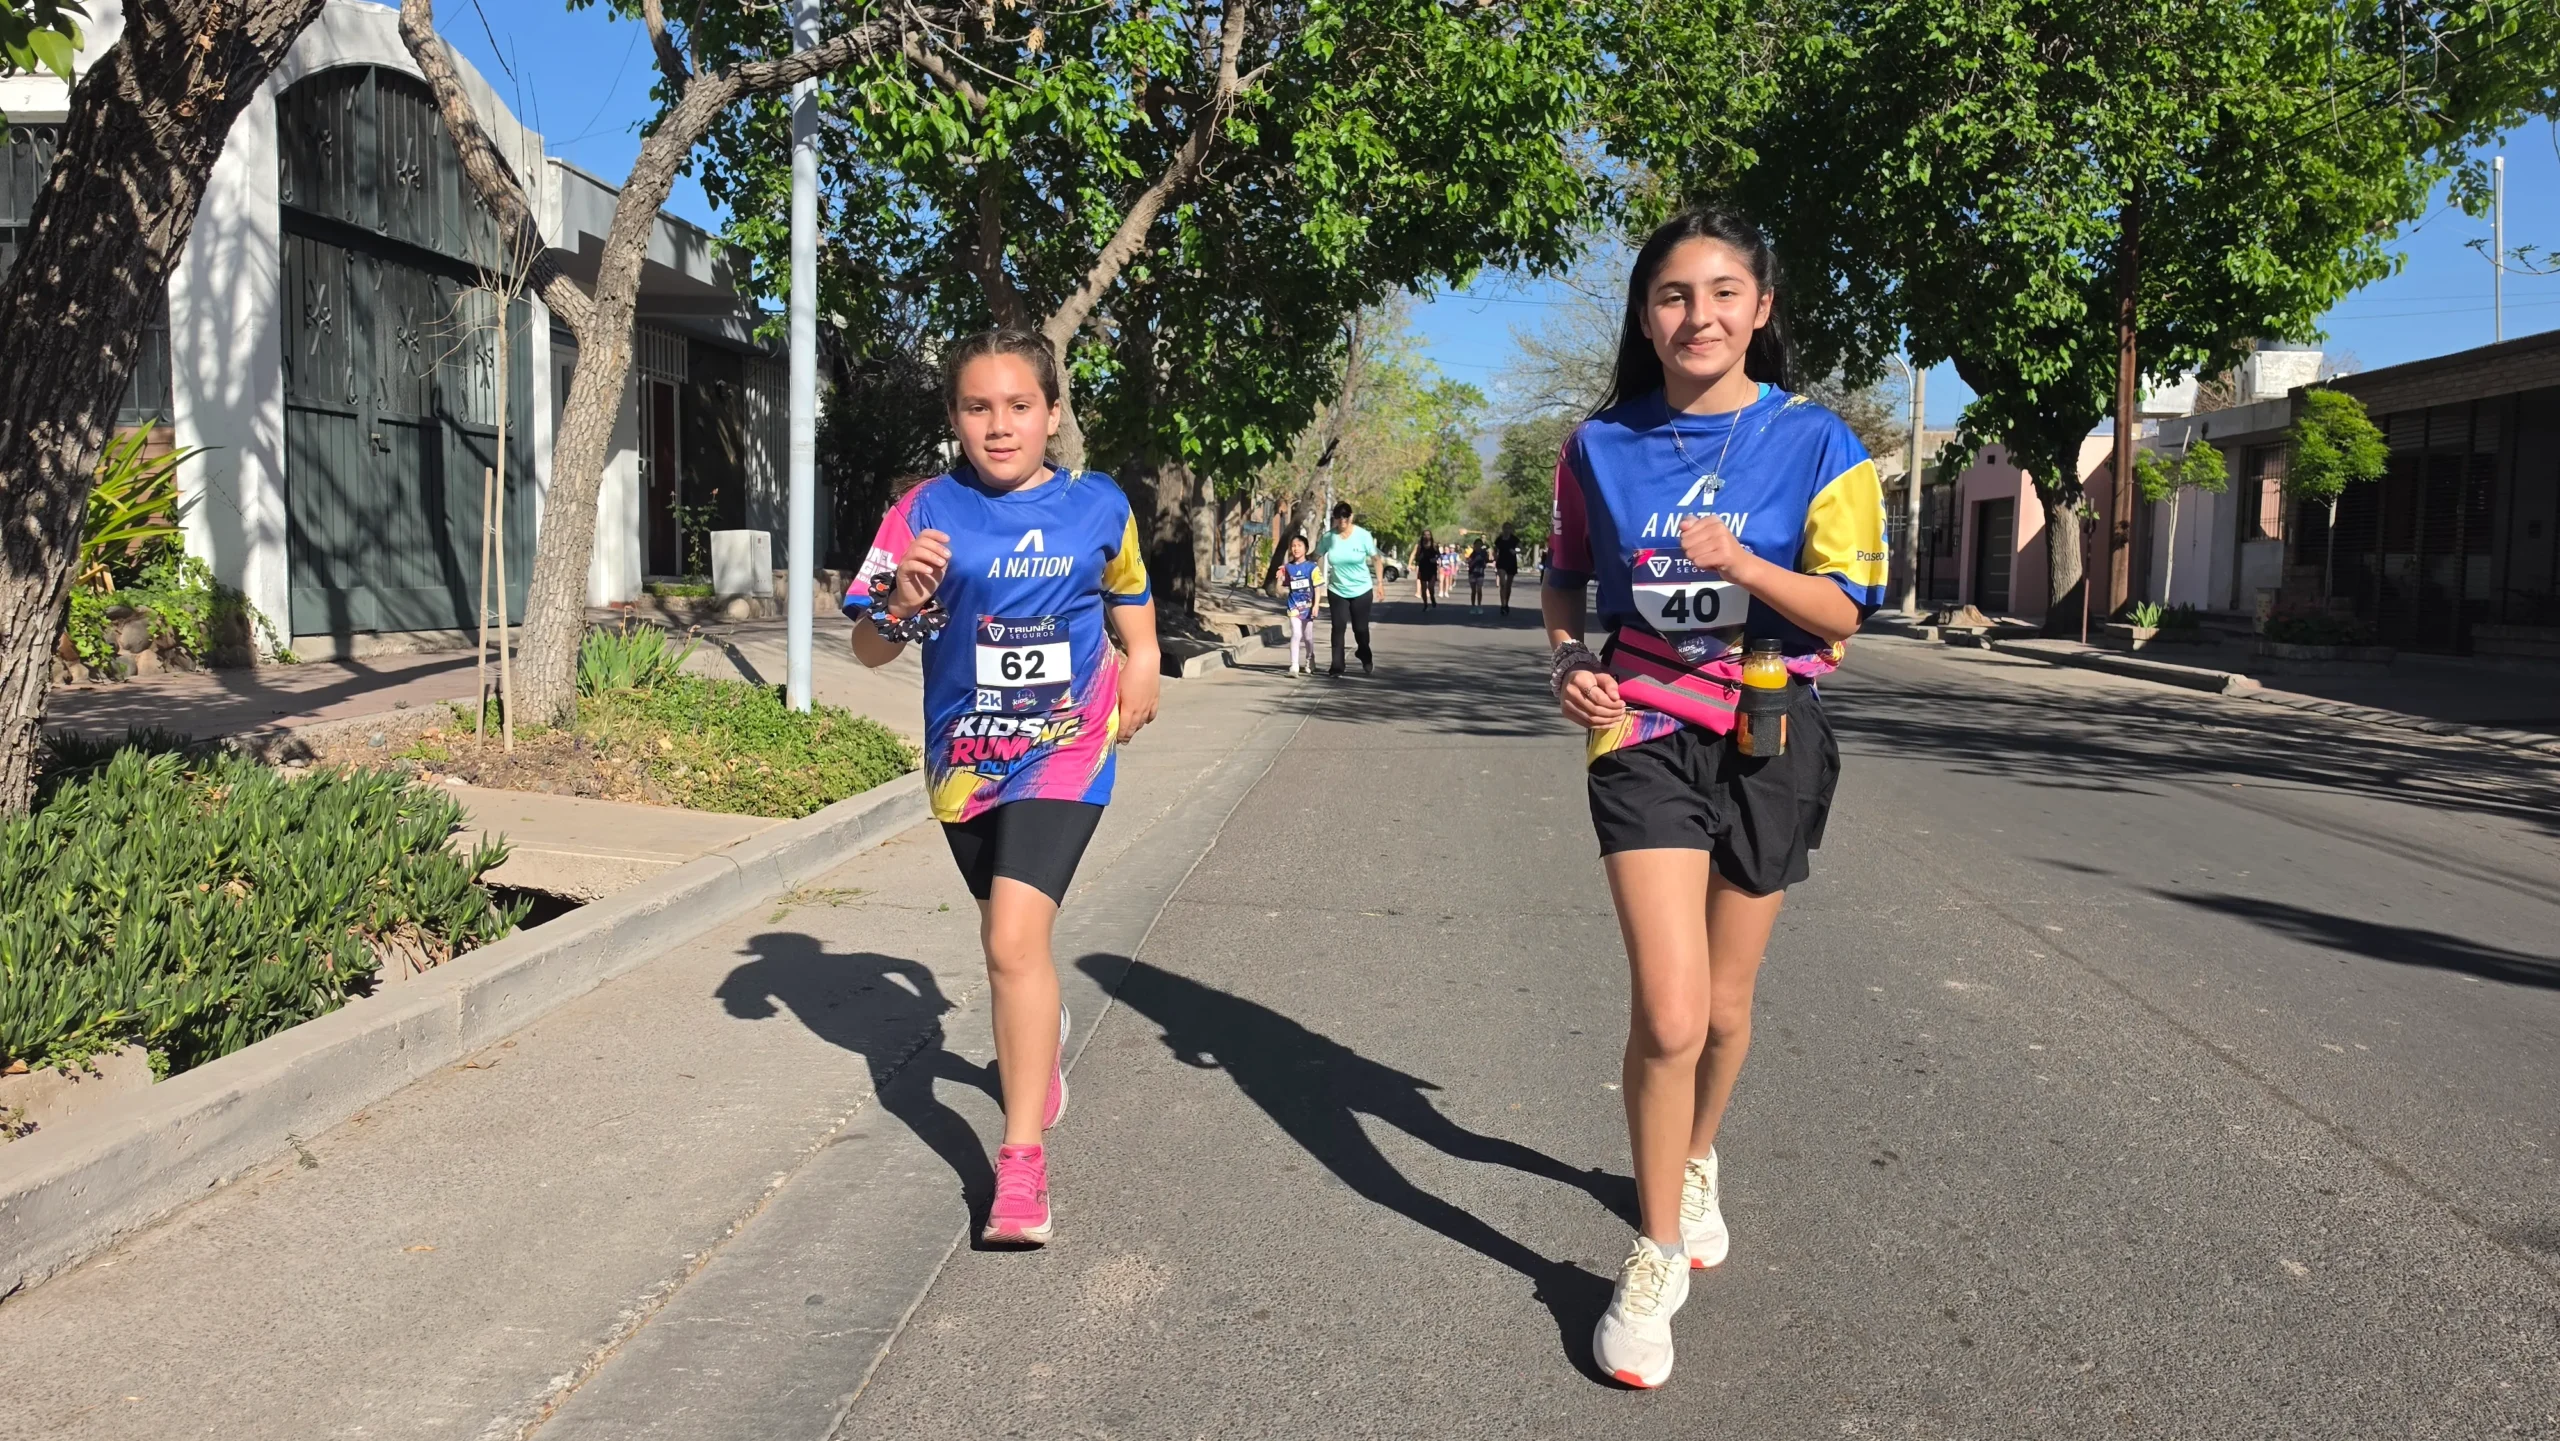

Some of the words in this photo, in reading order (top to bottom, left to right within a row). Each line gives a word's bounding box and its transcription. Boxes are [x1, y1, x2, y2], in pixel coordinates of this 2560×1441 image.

[1641, 512, 1658, 538] A
[1856, 550, 1885, 561] Paseo
[987, 557, 1000, 578] A
[1004, 556, 1074, 578] NATION
[1661, 587, 1720, 624] 40
[1007, 624, 1056, 634] TRIUNFO
[1009, 631, 1054, 640] SEGUROS
[1000, 650, 1046, 681] 62
[978, 692, 1001, 707] 2k
[952, 715, 1046, 738] KIDS
